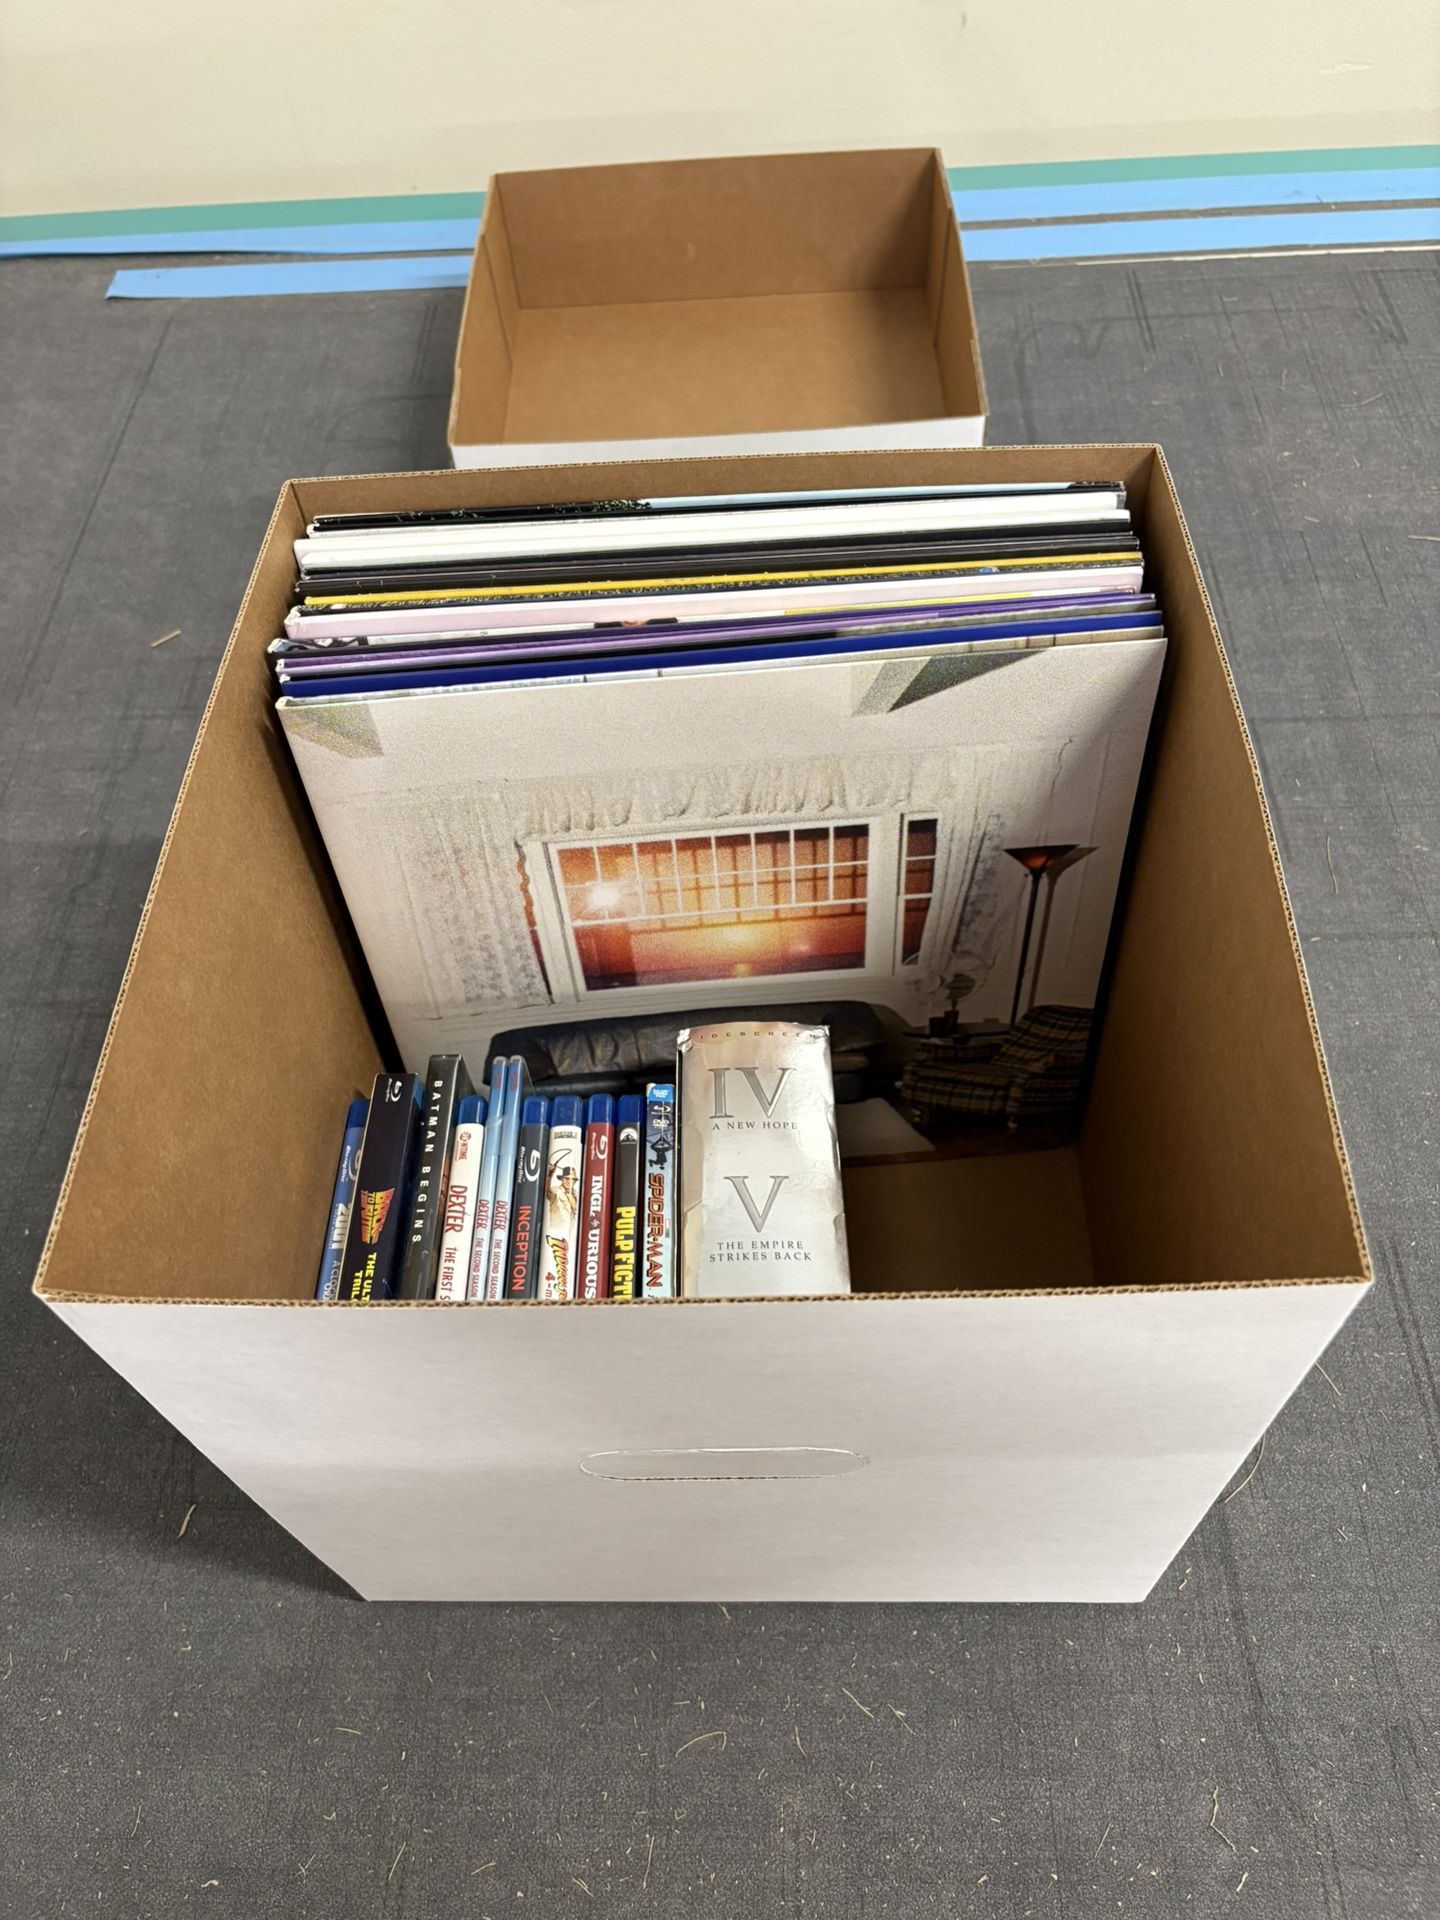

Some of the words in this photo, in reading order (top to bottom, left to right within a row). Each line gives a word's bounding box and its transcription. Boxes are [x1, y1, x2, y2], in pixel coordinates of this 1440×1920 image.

[708, 1066, 797, 1119] IV
[425, 1080, 443, 1152] BATMAN
[712, 1122, 720, 1131] A
[727, 1121, 756, 1130] NEW
[762, 1121, 798, 1130] HOPE
[371, 1187, 395, 1244] BACK
[412, 1166, 431, 1243] BEGINS
[445, 1184, 468, 1234] DEXTER
[475, 1199, 489, 1231] DEXTER
[493, 1200, 508, 1231] DEXTER
[723, 1175, 790, 1233] V
[615, 1206, 636, 1251] PULP
[646, 1172, 665, 1288] SPIDER-MAN
[444, 1246, 457, 1264] THE
[475, 1237, 484, 1248] THE
[493, 1238, 503, 1250] THE
[512, 1205, 532, 1291] INCEPTION
[716, 1240, 744, 1250] THE
[751, 1240, 804, 1250] EMPIRE
[365, 1252, 377, 1277] THE
[473, 1249, 482, 1273] SECOND
[491, 1251, 501, 1275] SECOND
[709, 1252, 768, 1263] STRIKES
[774, 1252, 813, 1262] BACK
[440, 1266, 455, 1292] FIRST
[470, 1274, 480, 1298] SEASON
[489, 1275, 499, 1299] SEASON
